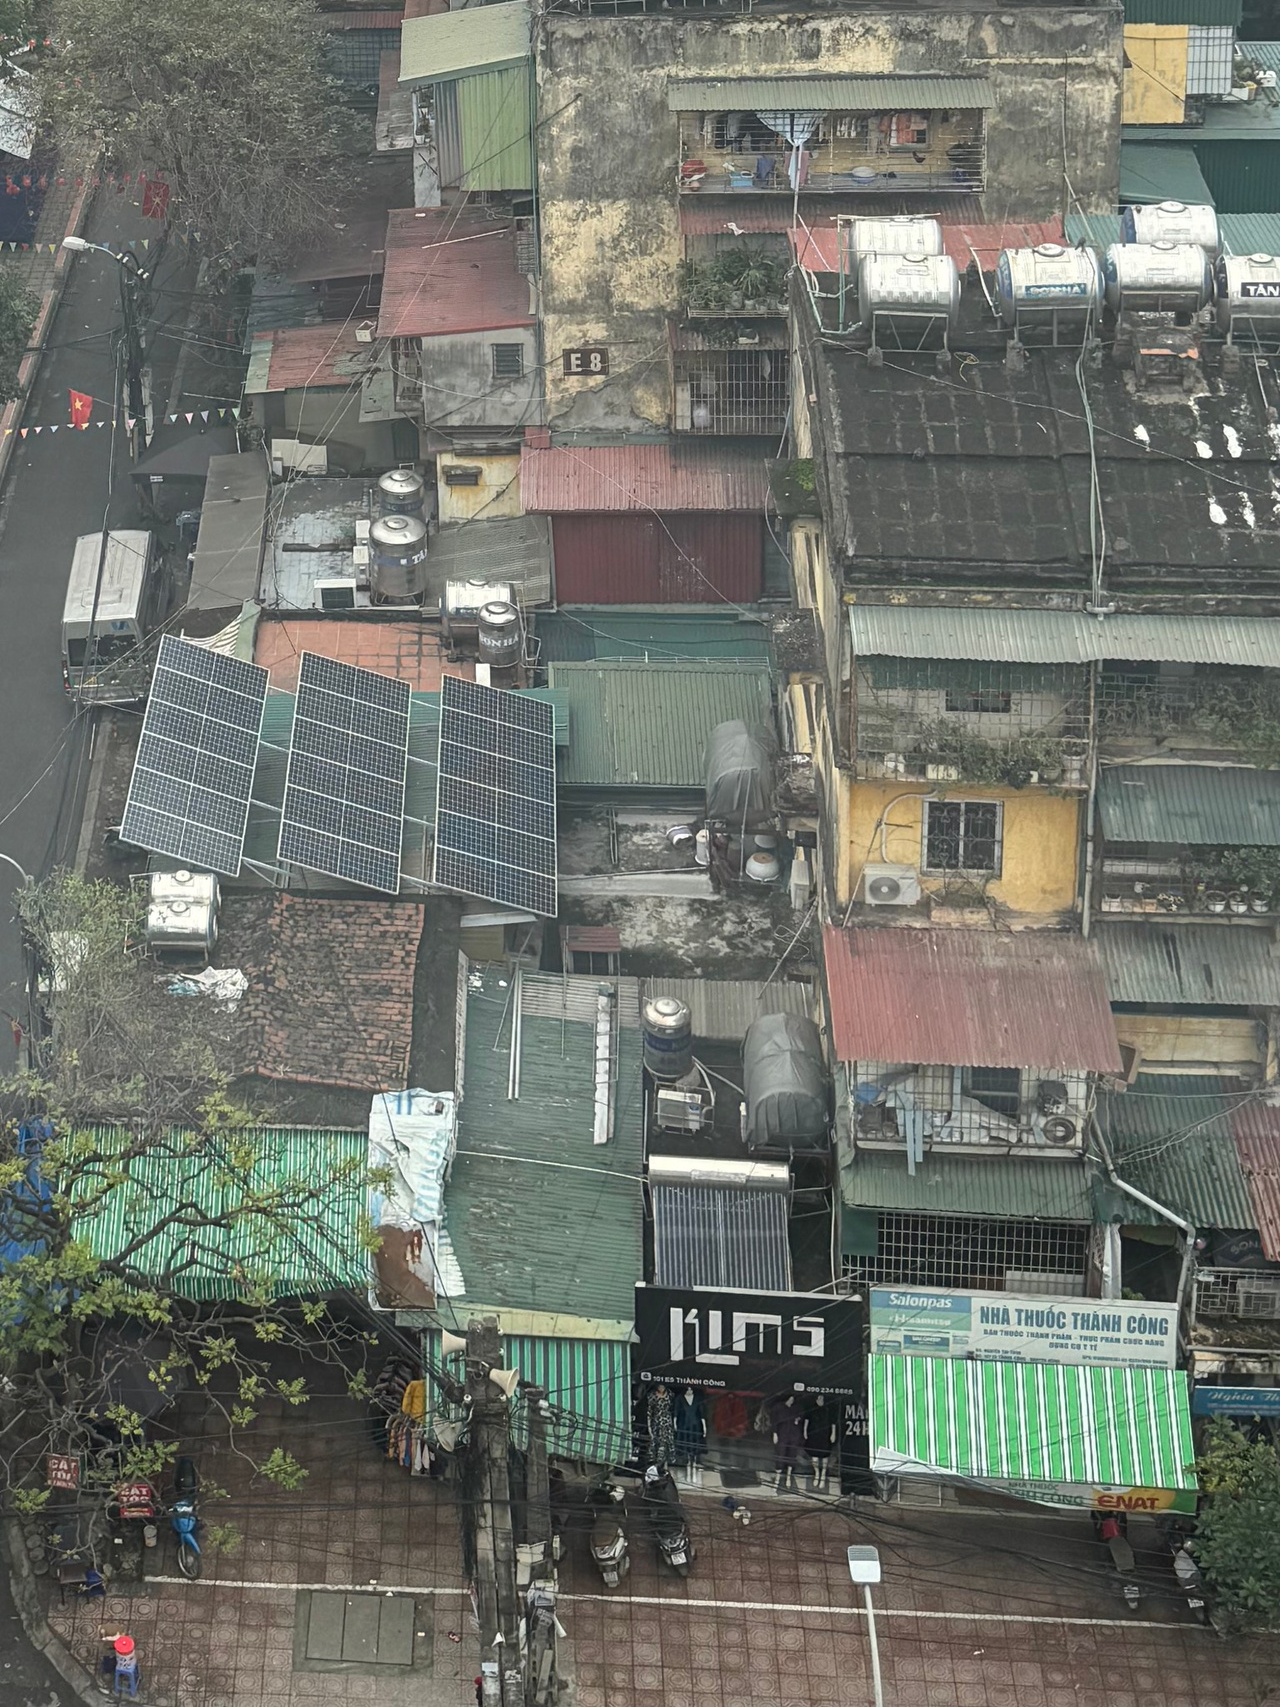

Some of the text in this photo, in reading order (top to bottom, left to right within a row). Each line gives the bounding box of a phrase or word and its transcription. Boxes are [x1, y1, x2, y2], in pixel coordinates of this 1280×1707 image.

[889, 1292, 953, 1310] Salonpas
[980, 1304, 1170, 1336] NHÀ THUỐC THÀNH CÔNG
[1097, 1495, 1160, 1511] ENAT
